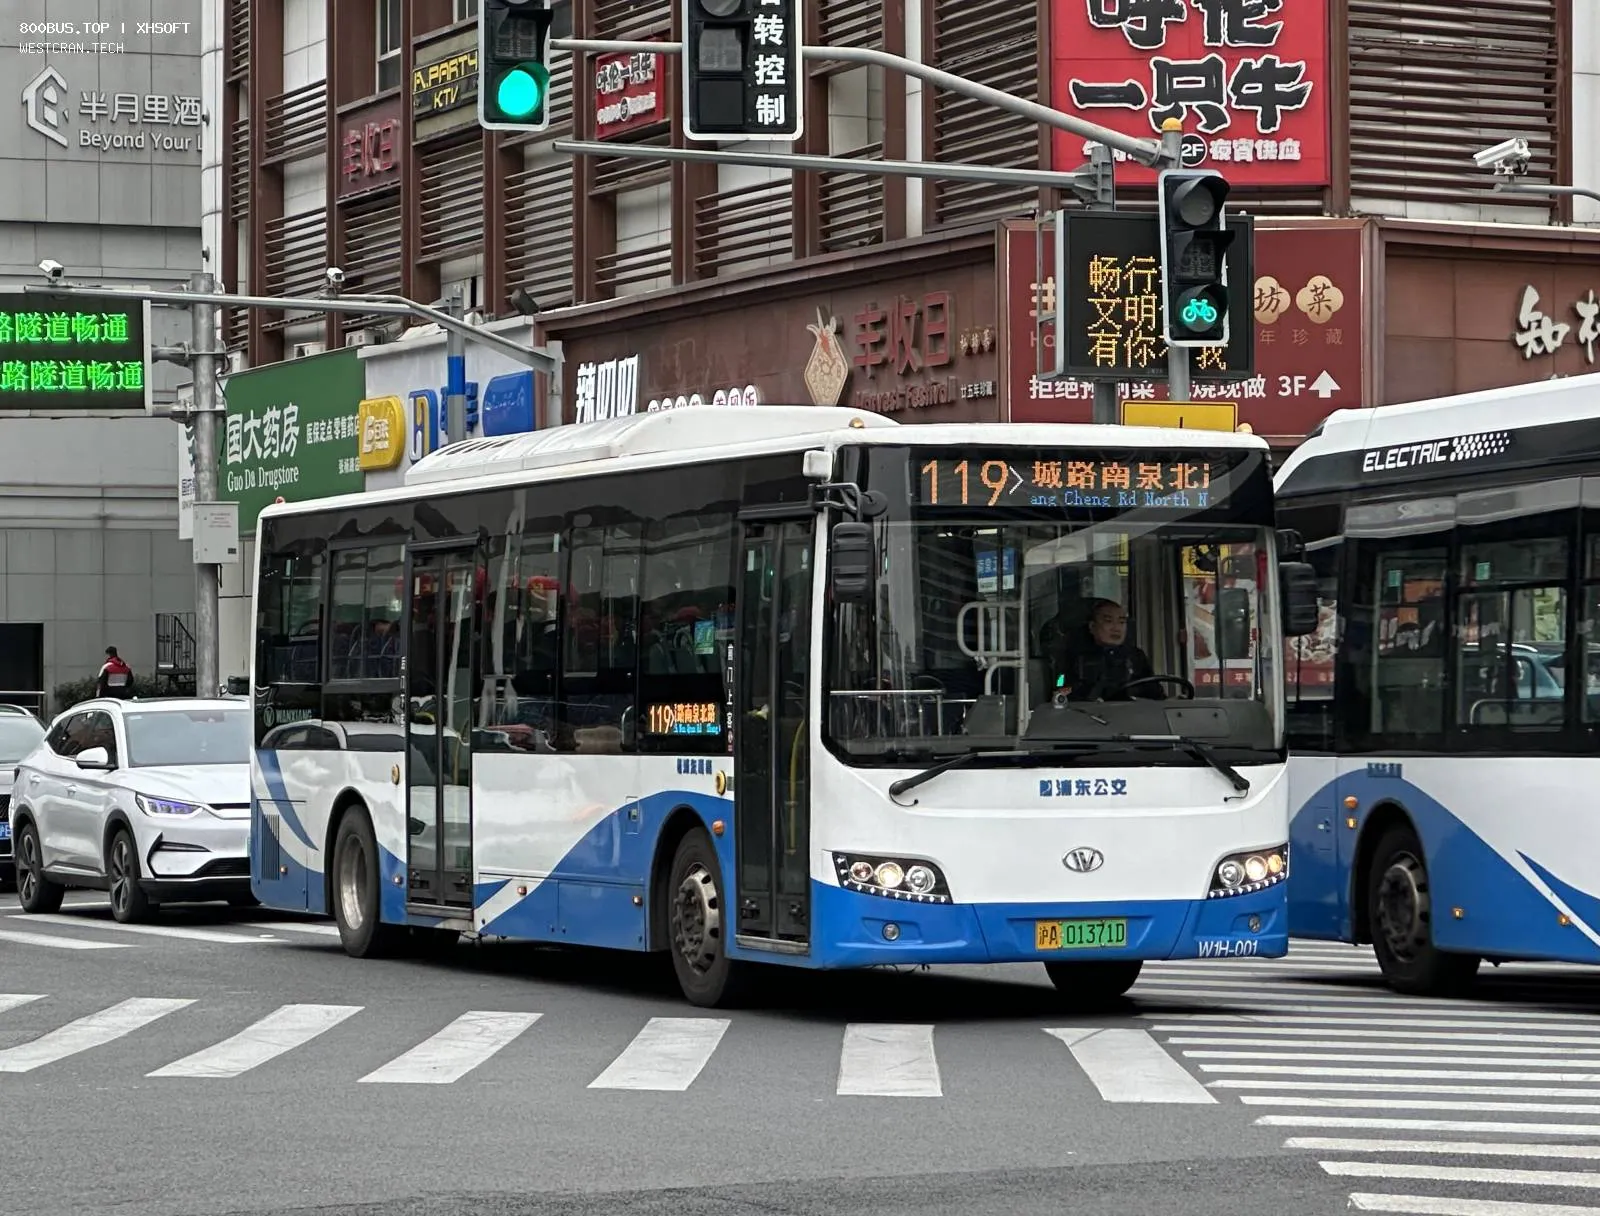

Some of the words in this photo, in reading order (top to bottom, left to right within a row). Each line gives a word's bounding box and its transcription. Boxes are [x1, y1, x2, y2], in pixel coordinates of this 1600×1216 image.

[753, 0, 785, 125] 转控制
[434, 84, 459, 109] KTV
[1069, 54, 1313, 134] 一只牛
[79, 129, 145, 151] Beyond
[150, 132, 191, 151] Your
[853, 291, 953, 379] 丰收日
[1278, 375, 1307, 397] 3F
[226, 402, 299, 466] 国大药房
[1363, 440, 1450, 473] ELECTRIC
[227, 470, 243, 493] Guo
[244, 467, 256, 488] Da
[258, 465, 299, 491] Drugstore
[920, 460, 1009, 507] 119
[1031, 460, 1210, 490] 城路南泉北
[1064, 491, 1111, 507] Cheng
[1118, 491, 1138, 507] Rd
[1144, 491, 1190, 507] North
[650, 705, 671, 734] 119
[1055, 779, 1128, 797] 浦东公交
[1038, 925, 1059, 946] 沪A
[1066, 922, 1126, 946] 01371D
[1198, 939, 1259, 957] W1H-001
